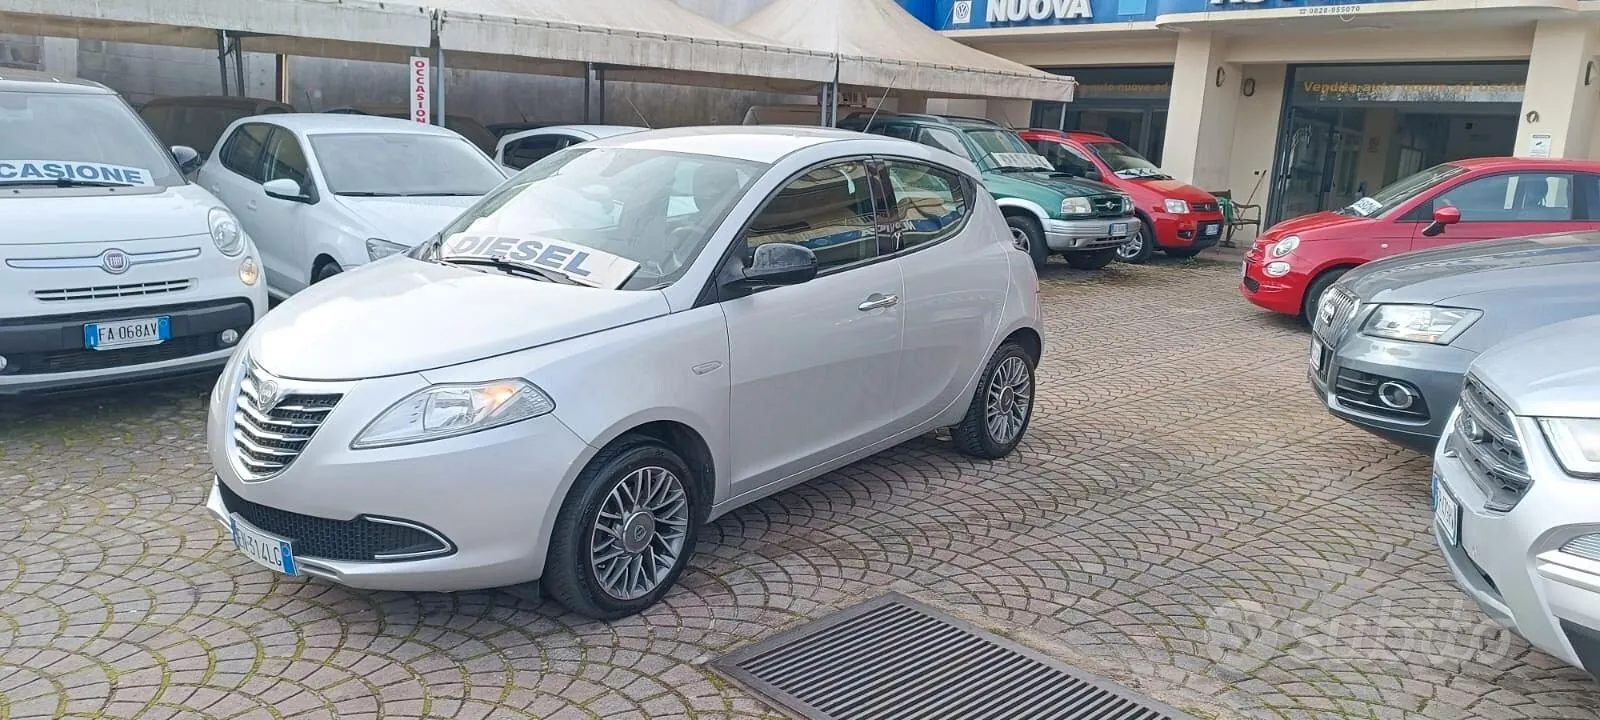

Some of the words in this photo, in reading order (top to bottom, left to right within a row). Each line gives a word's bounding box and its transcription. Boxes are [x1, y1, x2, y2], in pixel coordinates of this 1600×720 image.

[986, 0, 1093, 21] NUOVA
[449, 236, 592, 277] DIESEL
[98, 327, 114, 341] FA
[119, 323, 157, 340] 068AV
